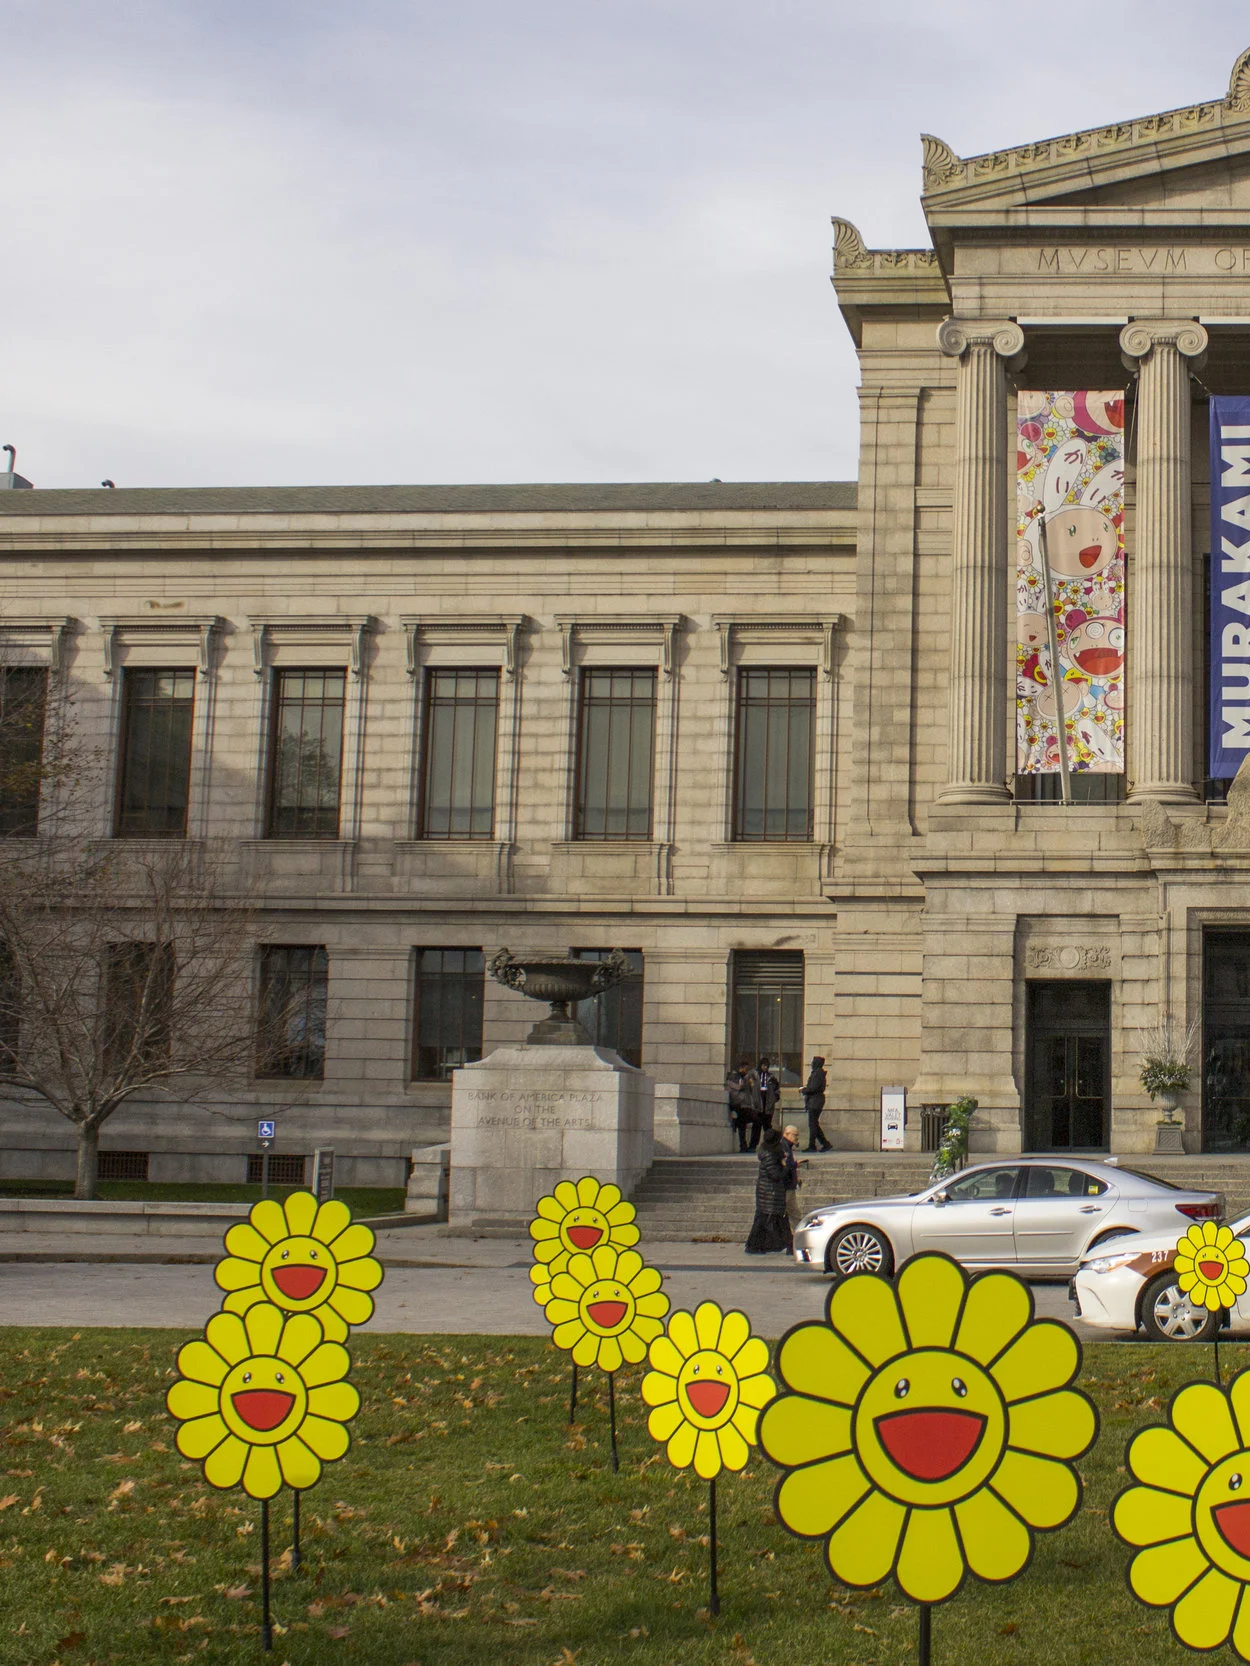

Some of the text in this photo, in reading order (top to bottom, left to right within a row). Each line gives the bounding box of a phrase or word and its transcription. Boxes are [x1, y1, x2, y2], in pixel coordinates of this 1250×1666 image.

[1037, 248, 1187, 271] MVSEVM
[468, 1092, 602, 1102] BANK OF AMERICA PLAZA
[514, 1105, 556, 1114] ON THE
[478, 1117, 593, 1128] AVENUE OF THE ARTS
[1152, 1249, 1168, 1263] 237
